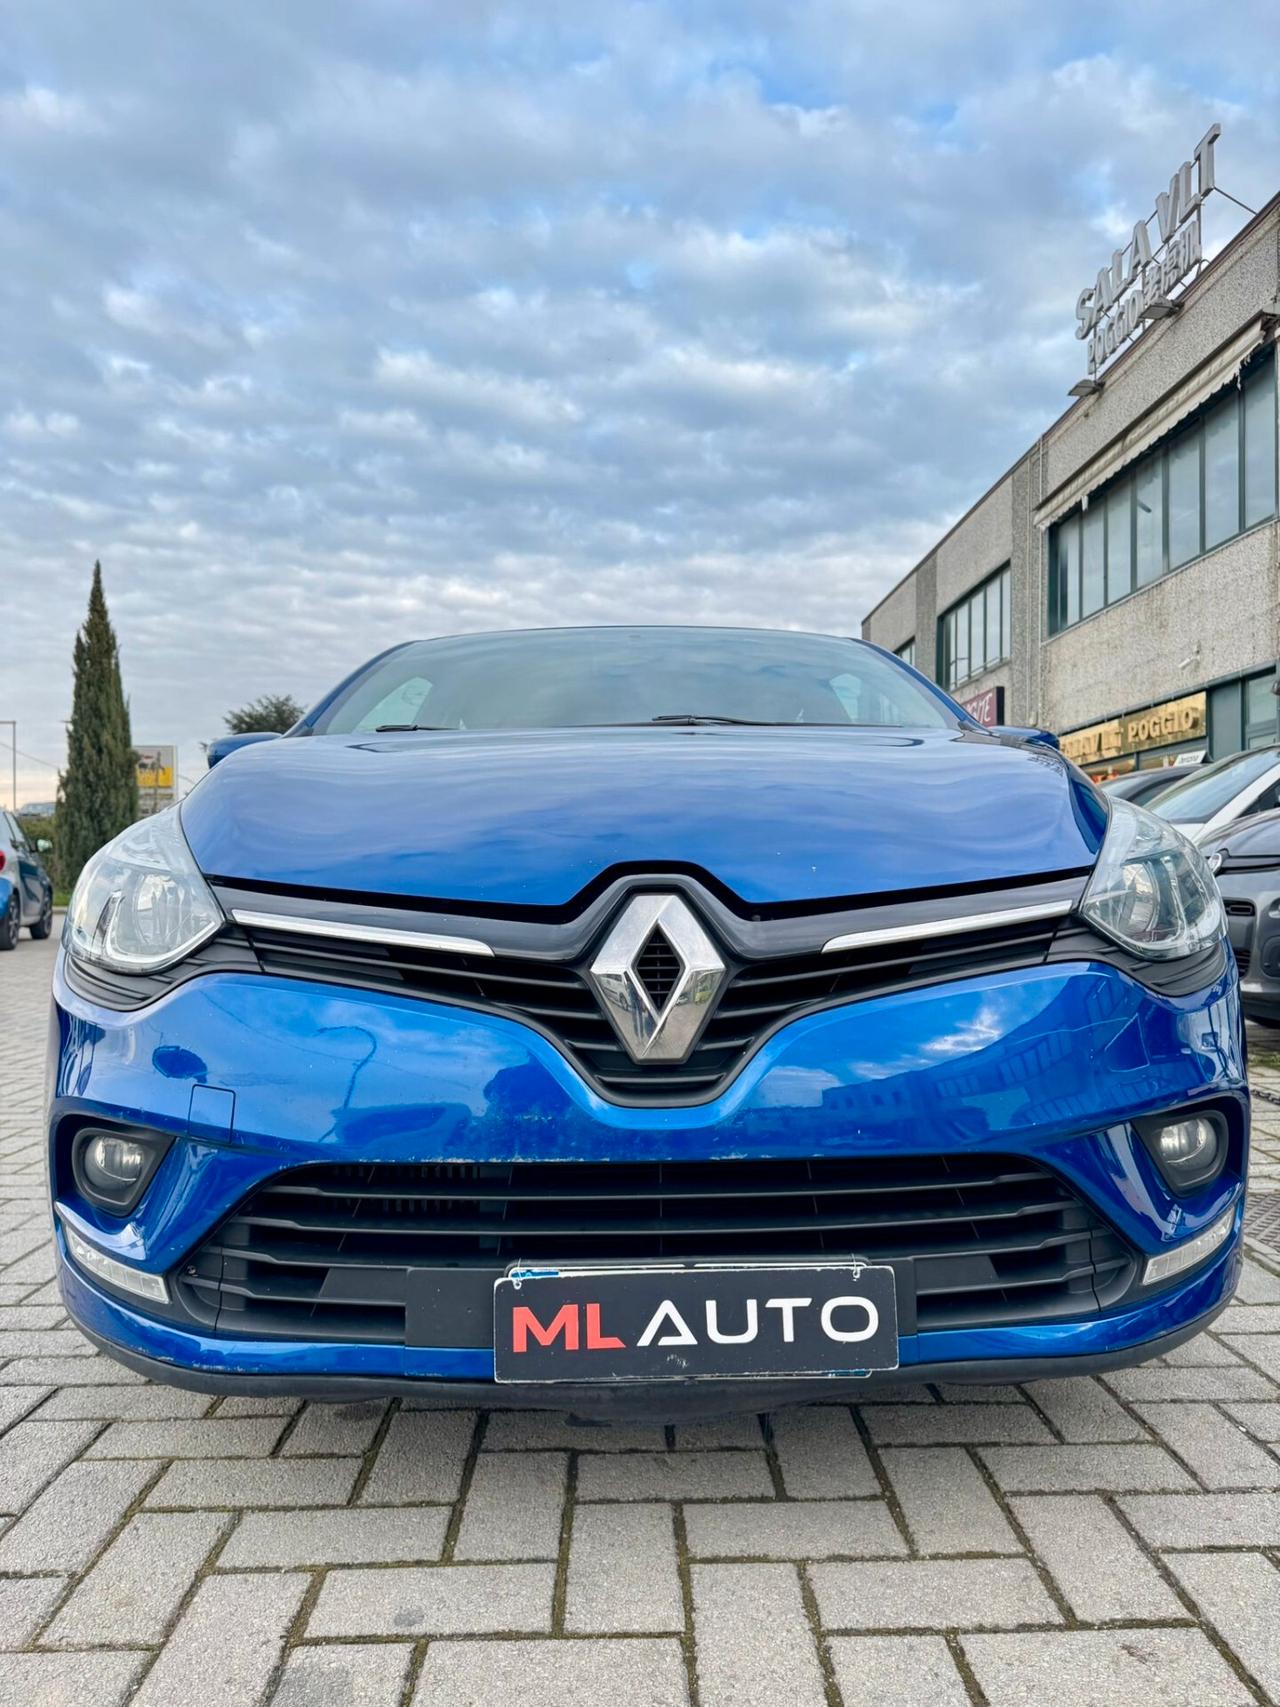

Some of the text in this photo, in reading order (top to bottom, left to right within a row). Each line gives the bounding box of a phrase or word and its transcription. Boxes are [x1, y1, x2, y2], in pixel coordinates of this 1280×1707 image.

[1075, 123, 1221, 340] SALA VLT
[1086, 290, 1145, 375] POGGIO
[1127, 708, 1195, 744] POGGIO
